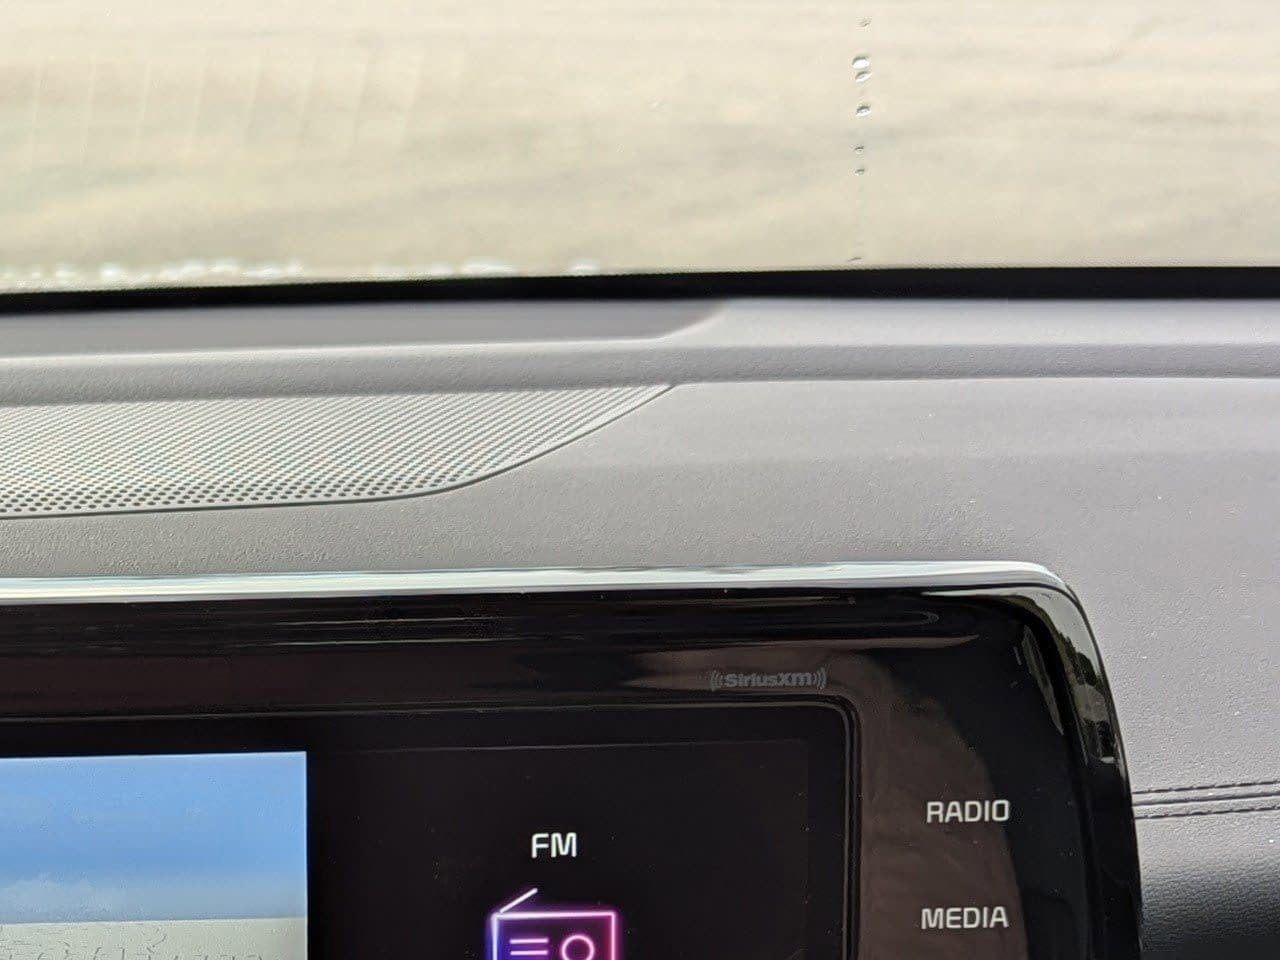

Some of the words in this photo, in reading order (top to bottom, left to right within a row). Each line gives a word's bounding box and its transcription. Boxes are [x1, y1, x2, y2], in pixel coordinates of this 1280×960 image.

[926, 800, 1010, 823] RADIO
[531, 832, 578, 858] FM
[920, 906, 1010, 930] MEDIA
